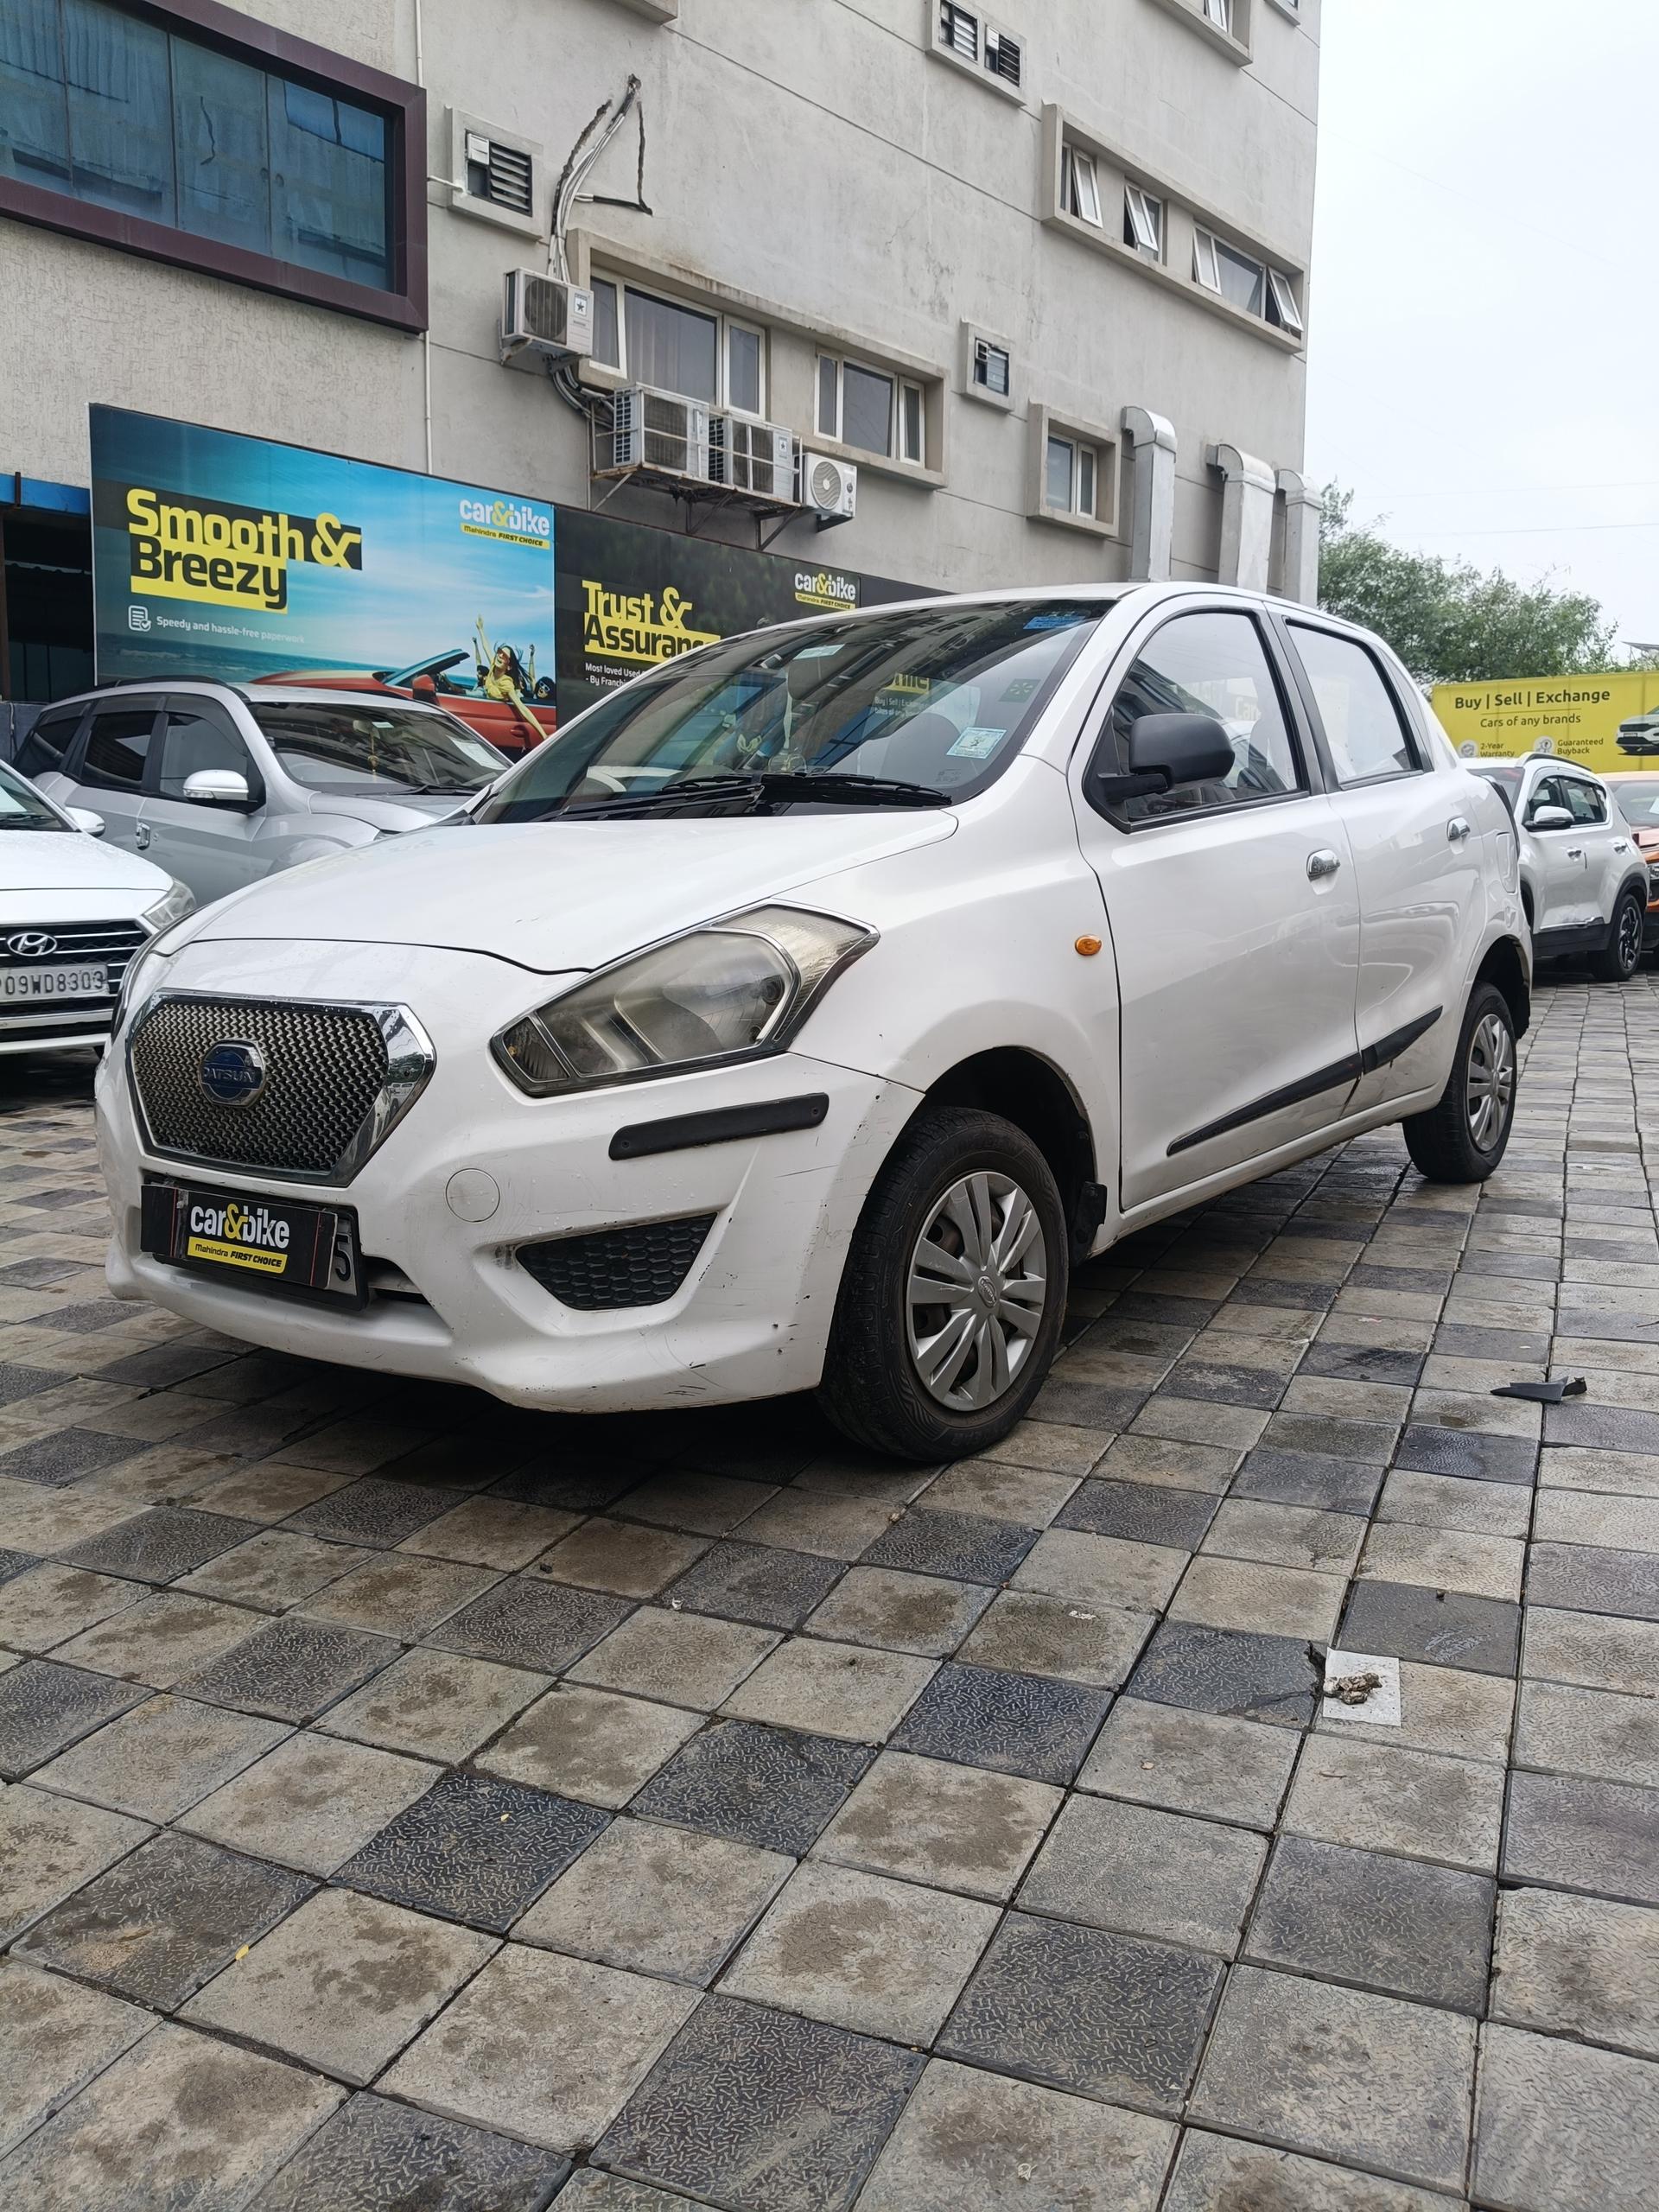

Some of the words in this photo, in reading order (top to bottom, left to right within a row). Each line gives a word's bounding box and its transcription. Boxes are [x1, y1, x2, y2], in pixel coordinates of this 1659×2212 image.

[127, 488, 304, 562] Smooth
[311, 512, 361, 569] &
[460, 499, 550, 536] car&bike
[499, 532, 518, 541] FIRST
[519, 537, 543, 546] CHOICE
[131, 534, 287, 610] Breezy
[795, 573, 855, 601] car&bike
[582, 580, 654, 624] Trust
[660, 587, 692, 630] &
[156, 616, 191, 631] Speedy
[193, 622, 209, 632] and
[212, 623, 259, 638] hassle-free
[261, 632, 304, 643] paperwork
[584, 614, 712, 658] Assuran
[585, 663, 603, 673] Most
[604, 665, 622, 676] loved
[624, 669, 641, 677] Used
[590, 676, 600, 686] By
[1455, 696, 1482, 710] Buy
[1495, 692, 1522, 706] Sell
[1536, 690, 1611, 703] Exchange
[1480, 719, 1503, 728] Cars
[1506, 715, 1518, 726] of
[1521, 716, 1540, 727] any
[1543, 714, 1581, 724] brands
[1557, 747, 1590, 756] Buyback
[1558, 738, 1604, 747] Guaranteed
[0, 970, 105, 995] 09WD8303
[190, 1203, 289, 1249] car&bike
[194, 1243, 228, 1257] Mahindra
[230, 1250, 252, 1262] FIRST
[252, 1255, 282, 1268] CHOICE
